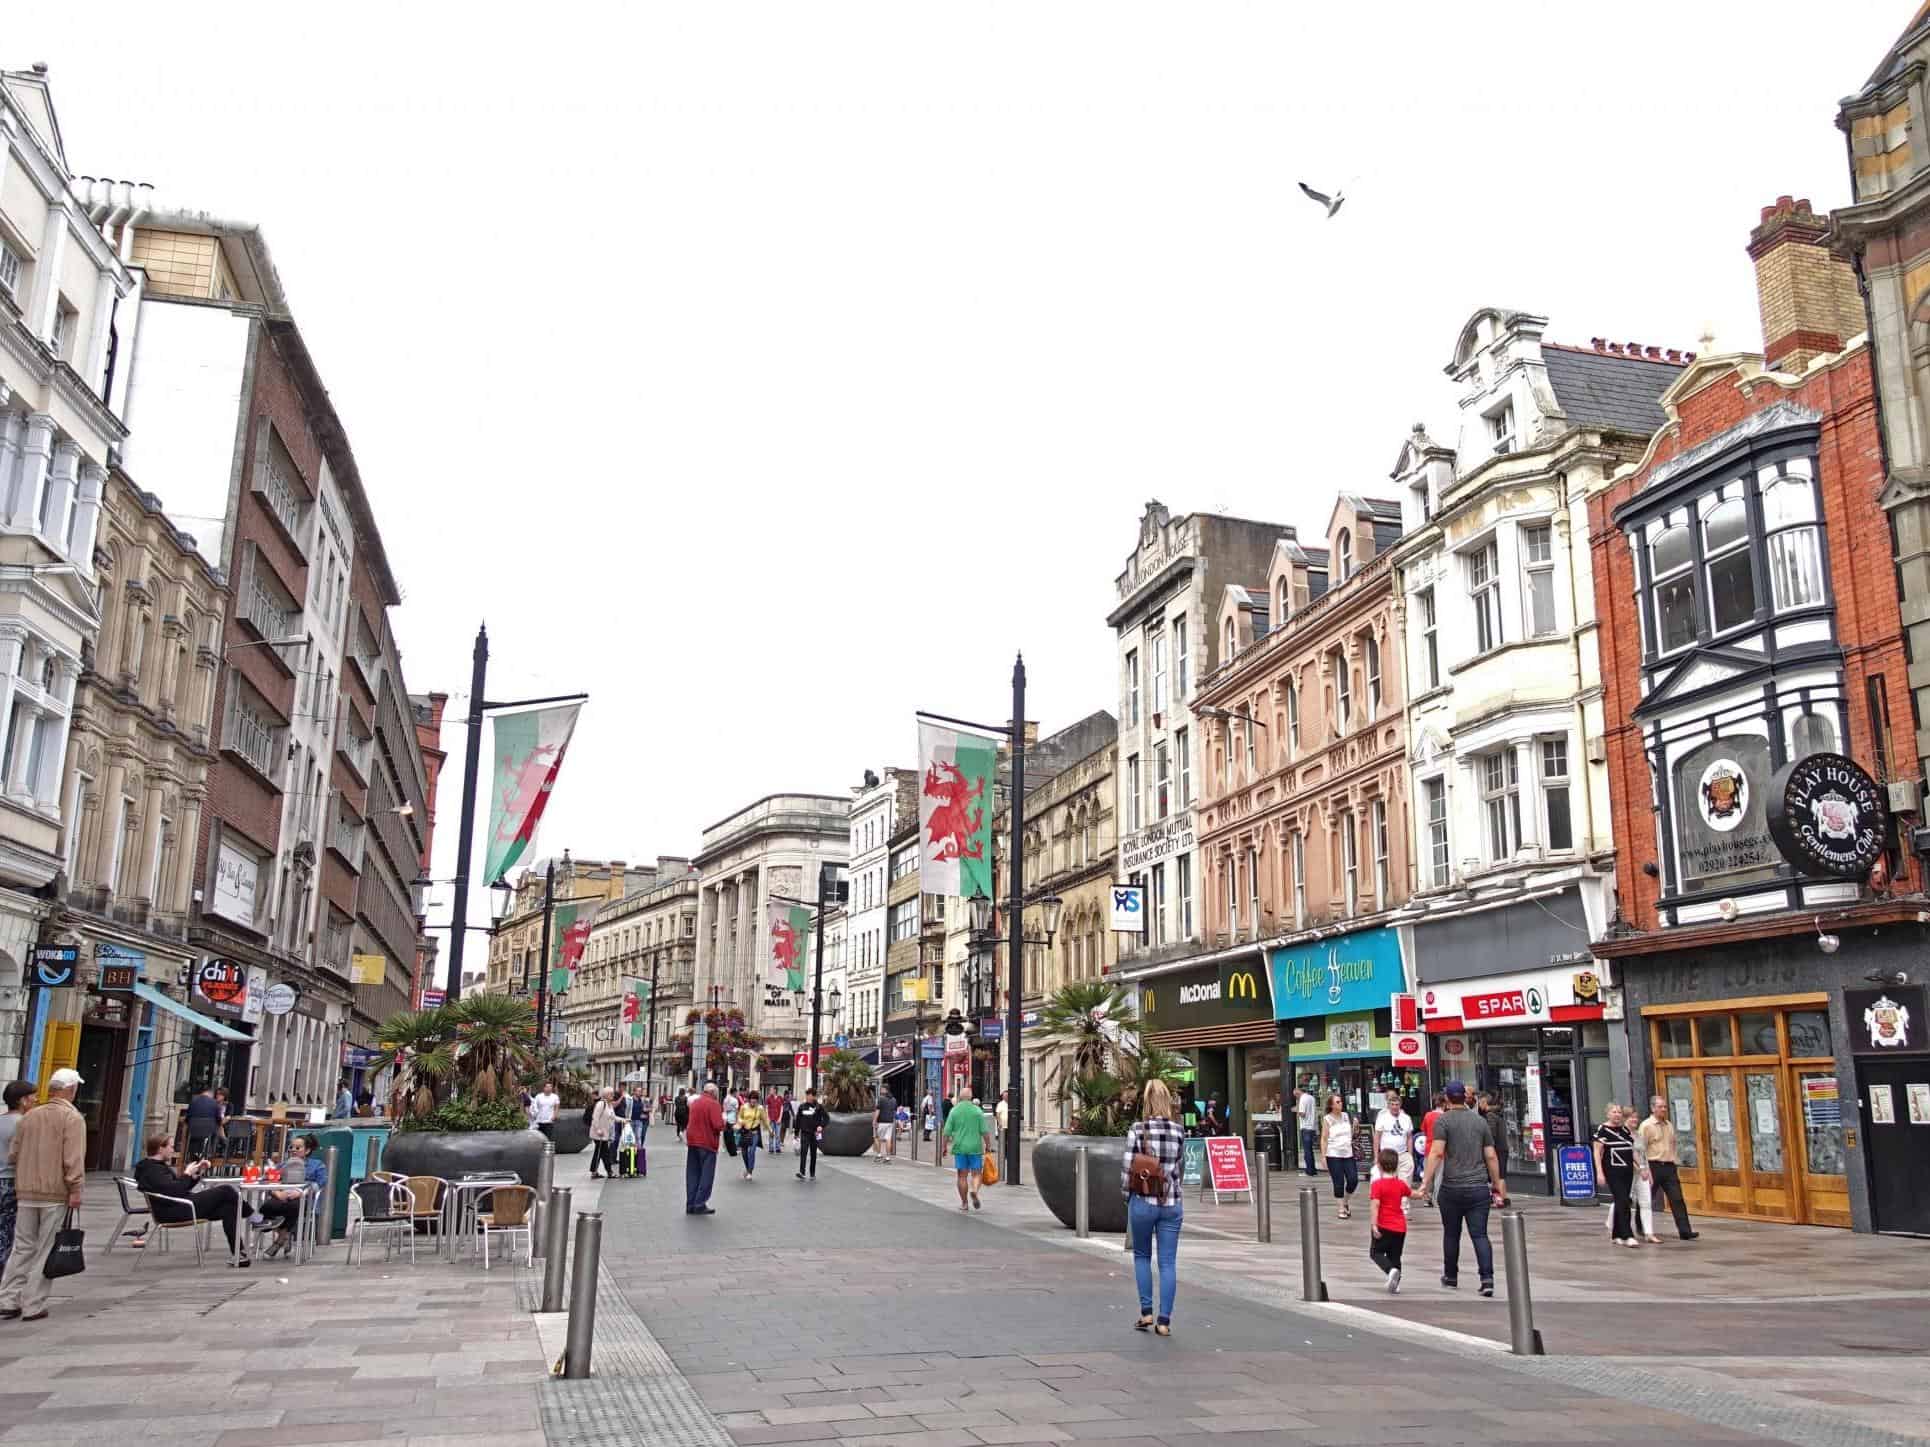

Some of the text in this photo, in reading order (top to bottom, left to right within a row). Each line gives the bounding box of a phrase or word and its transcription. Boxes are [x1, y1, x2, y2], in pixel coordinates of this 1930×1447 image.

[1137, 550, 1168, 585] LONDON
[1795, 767, 1874, 813] PLAY HOUSE
[1122, 815, 1193, 854] ROYAL LONDON MUTUAL
[1801, 824, 1874, 863] Gentlemens Club
[1123, 847, 1154, 869] INSURANCE
[1154, 837, 1179, 858] SOCIETY
[1286, 955, 1326, 1000] Coffee
[1478, 995, 1526, 1016] SPAR
[1565, 1162, 1588, 1171] FREE
[1567, 1171, 1589, 1180] CASH
